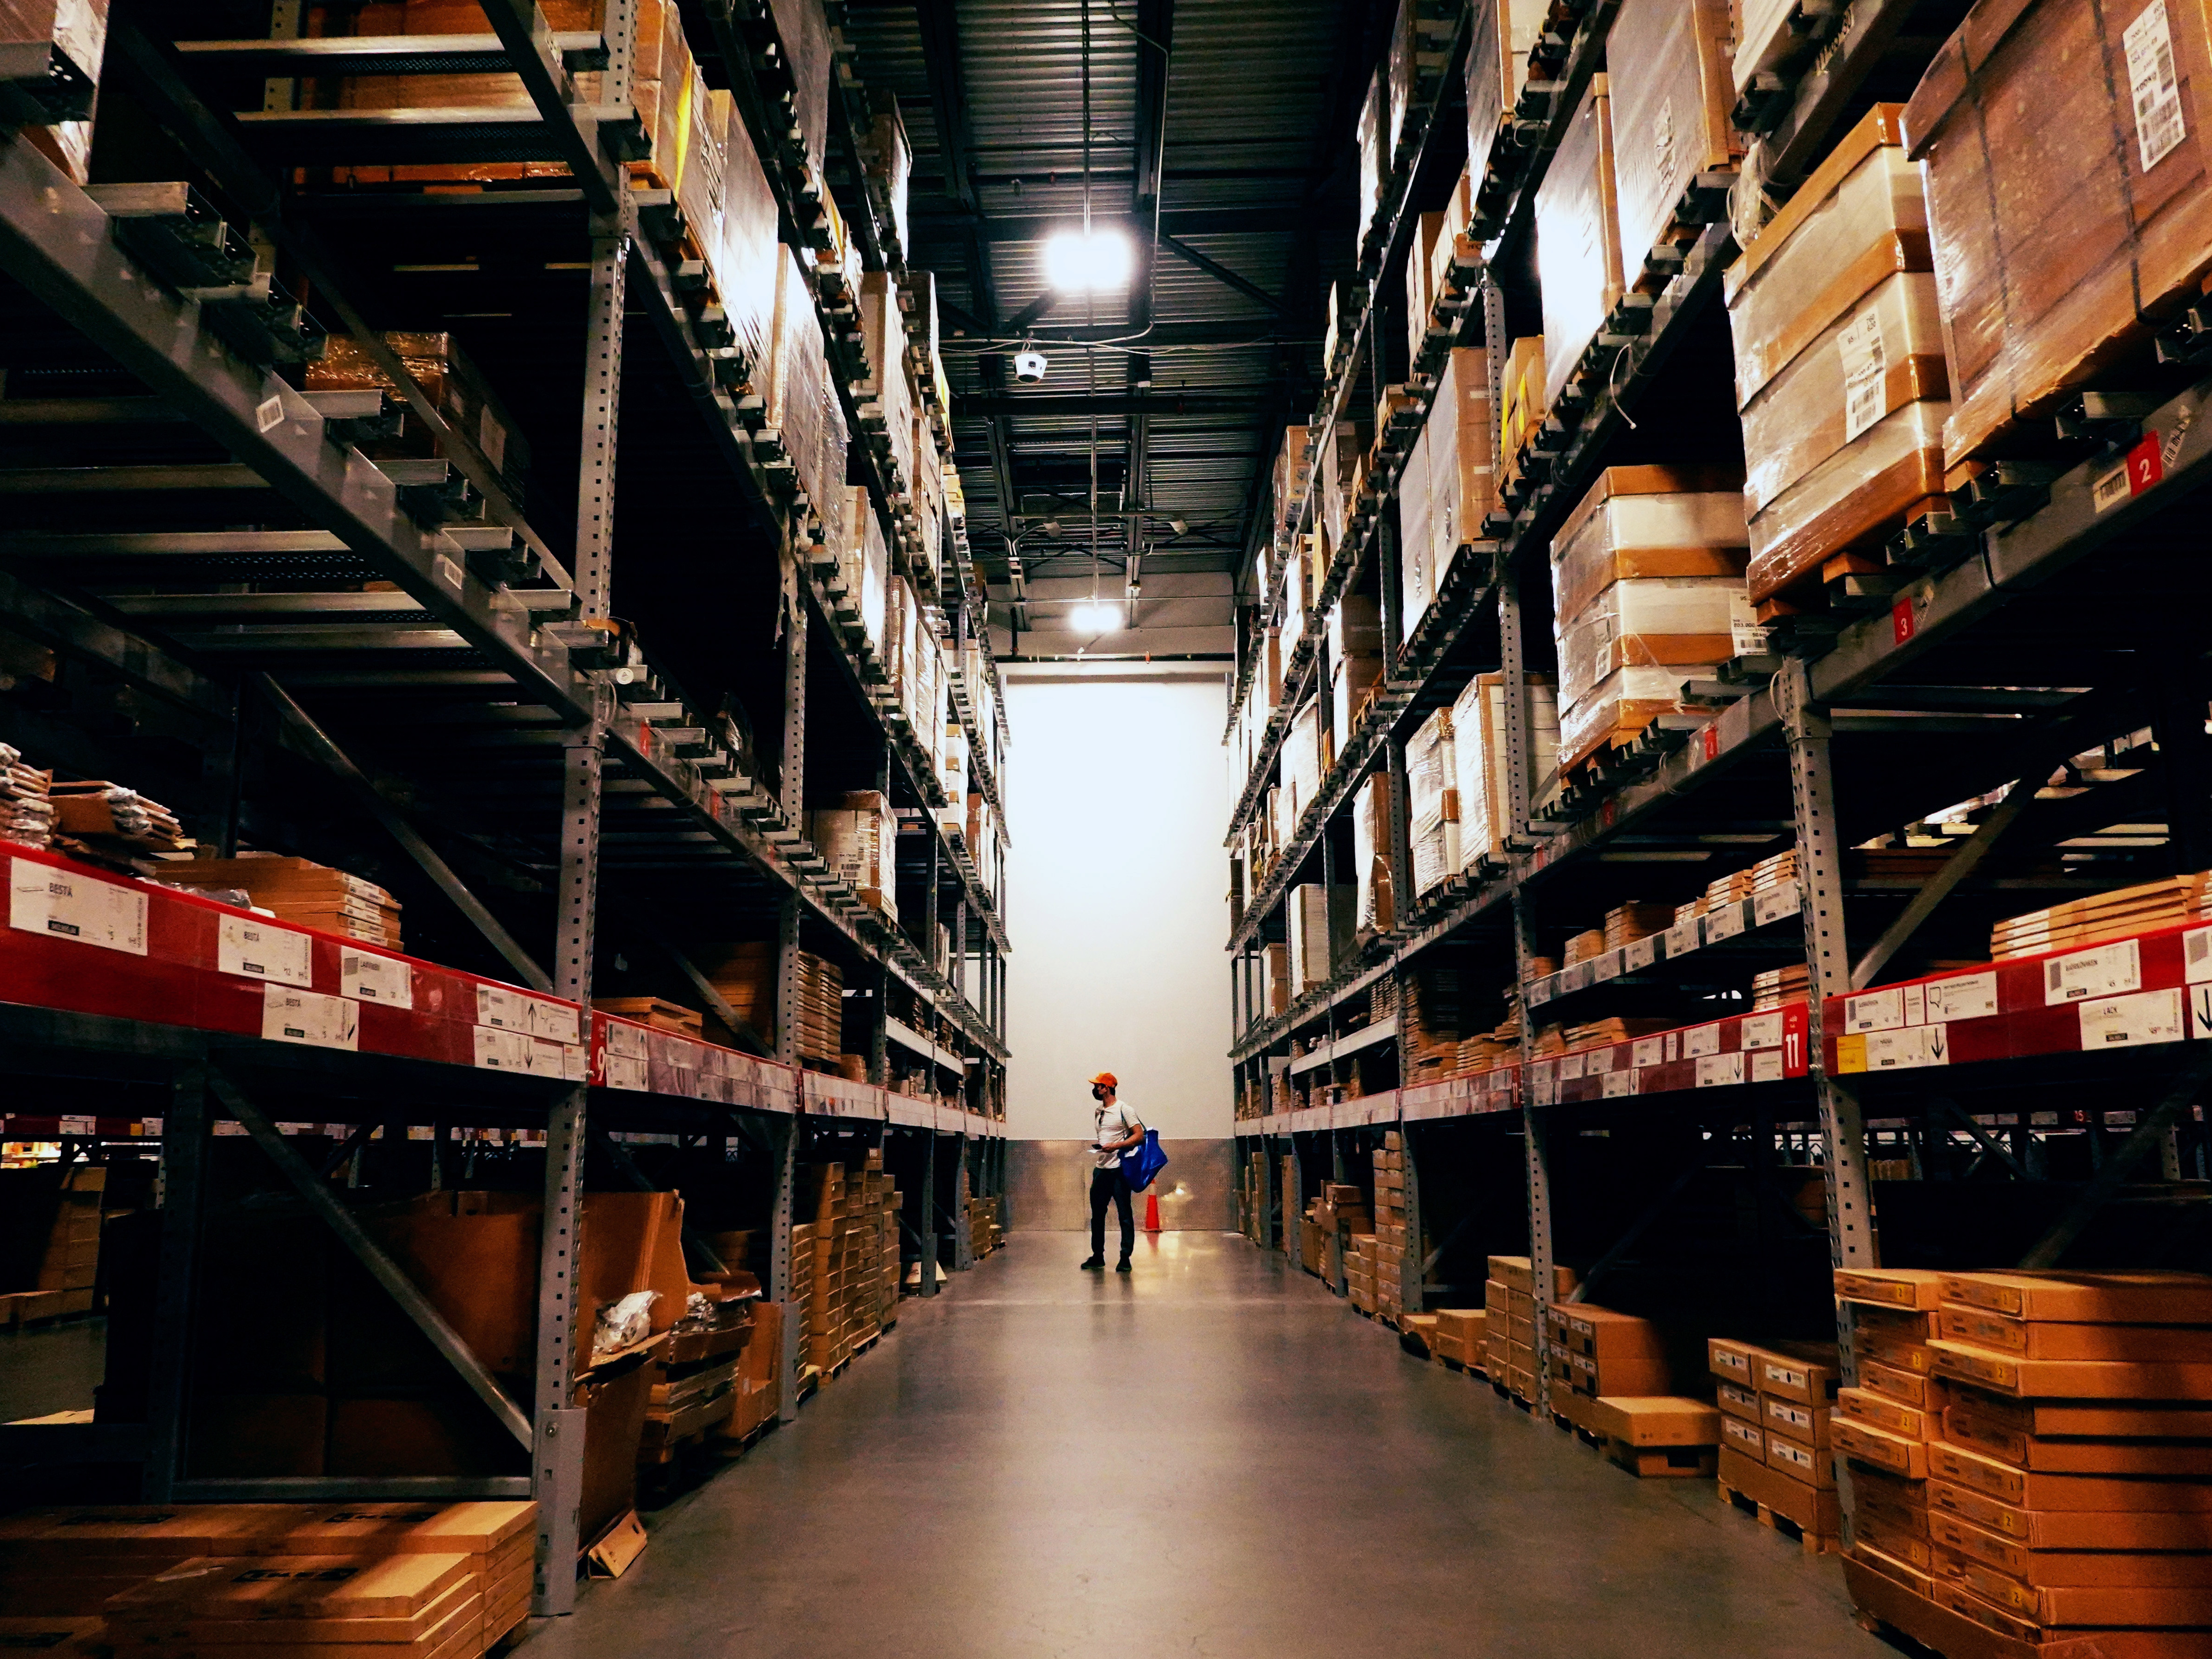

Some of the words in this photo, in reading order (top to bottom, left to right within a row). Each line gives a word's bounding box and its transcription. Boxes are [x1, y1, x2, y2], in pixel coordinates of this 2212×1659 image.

[2139, 458, 2151, 483] 2
[1901, 617, 1908, 636] 3
[597, 1046, 605, 1081] 9
[1785, 1033, 1799, 1069] 11
